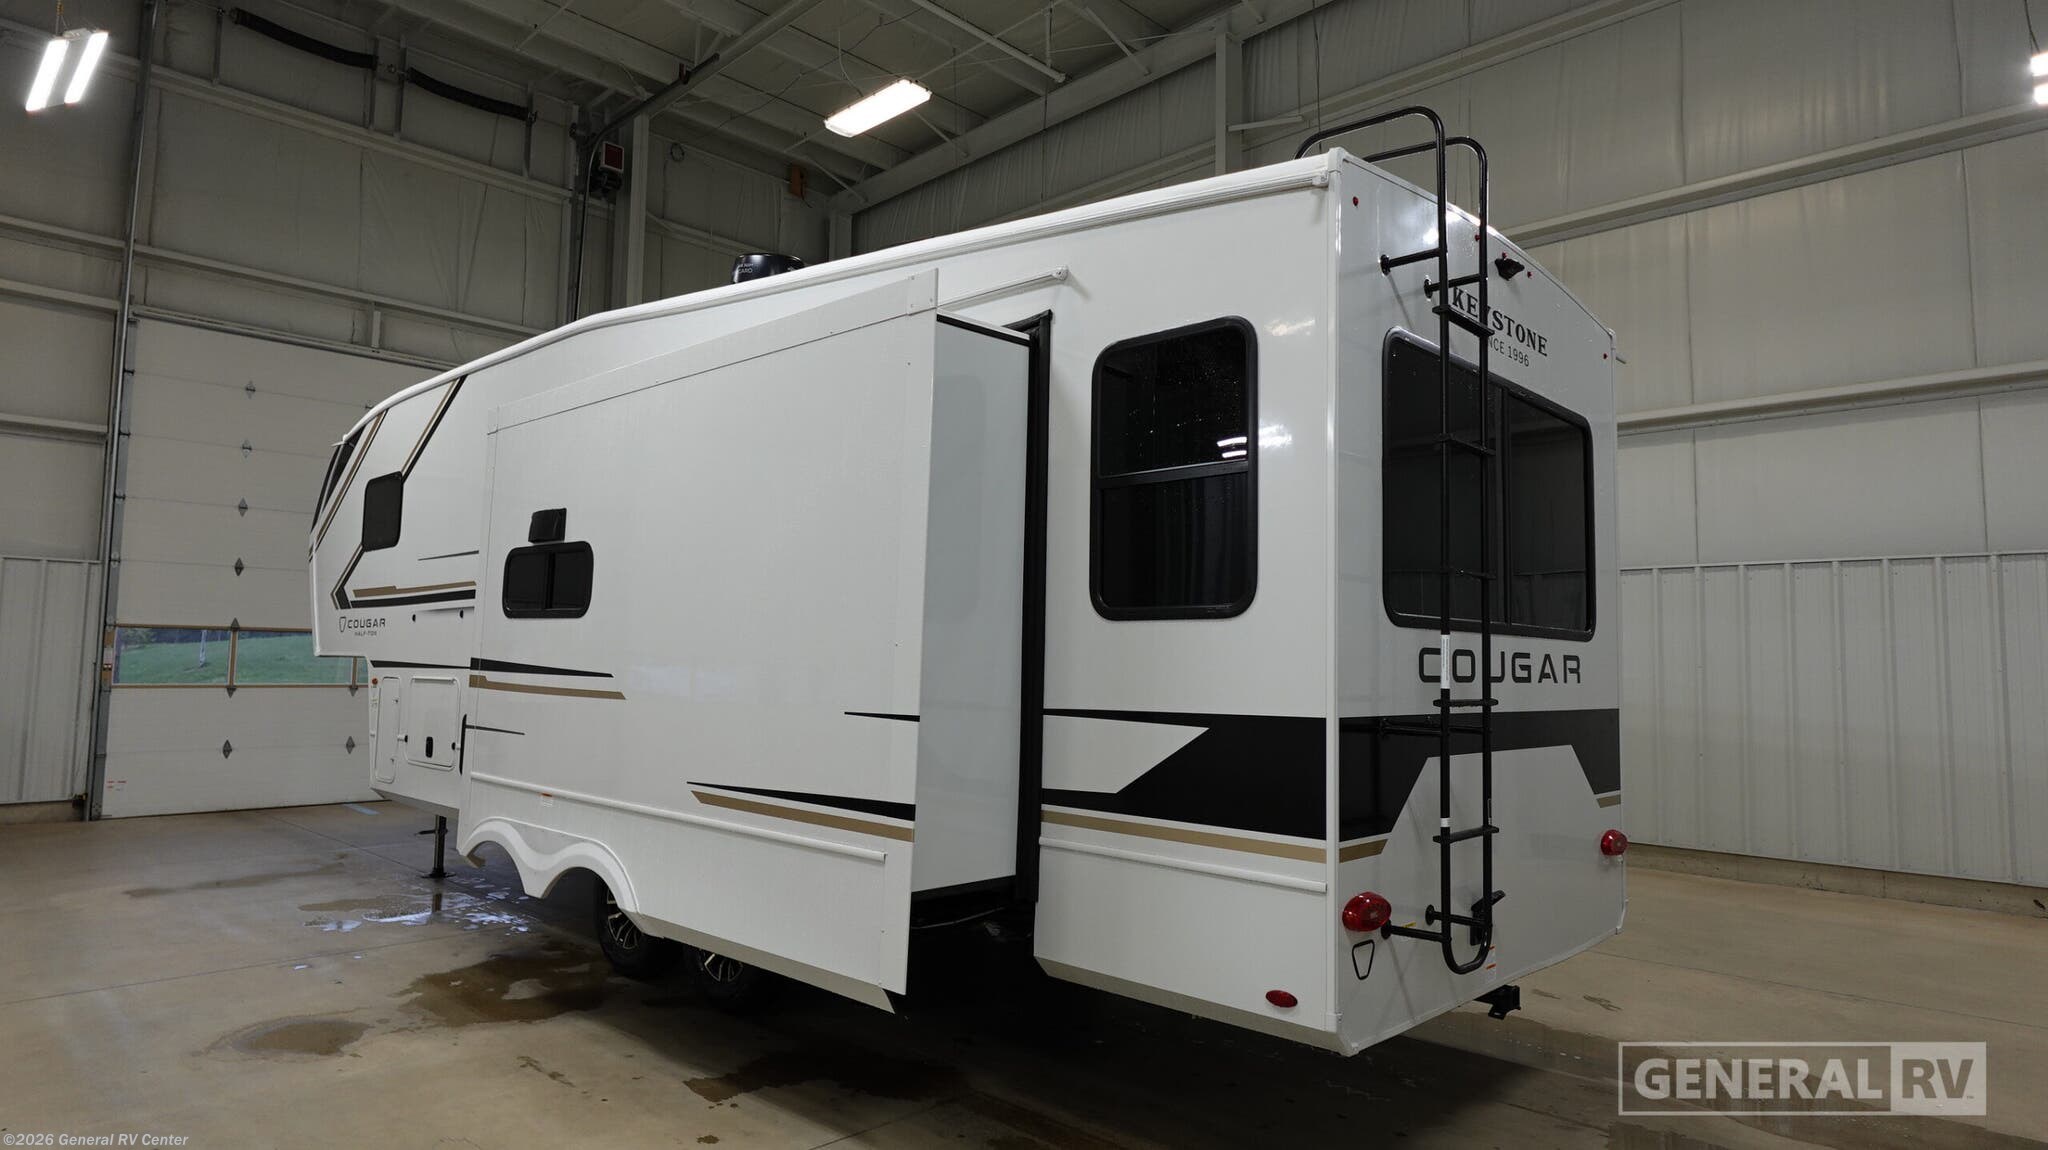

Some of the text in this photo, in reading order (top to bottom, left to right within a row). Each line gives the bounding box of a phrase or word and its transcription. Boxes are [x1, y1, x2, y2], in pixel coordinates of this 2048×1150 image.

[1507, 345, 1530, 367] 1996
[347, 618, 386, 629] COUGAR
[1418, 647, 1581, 684] COUGAR
